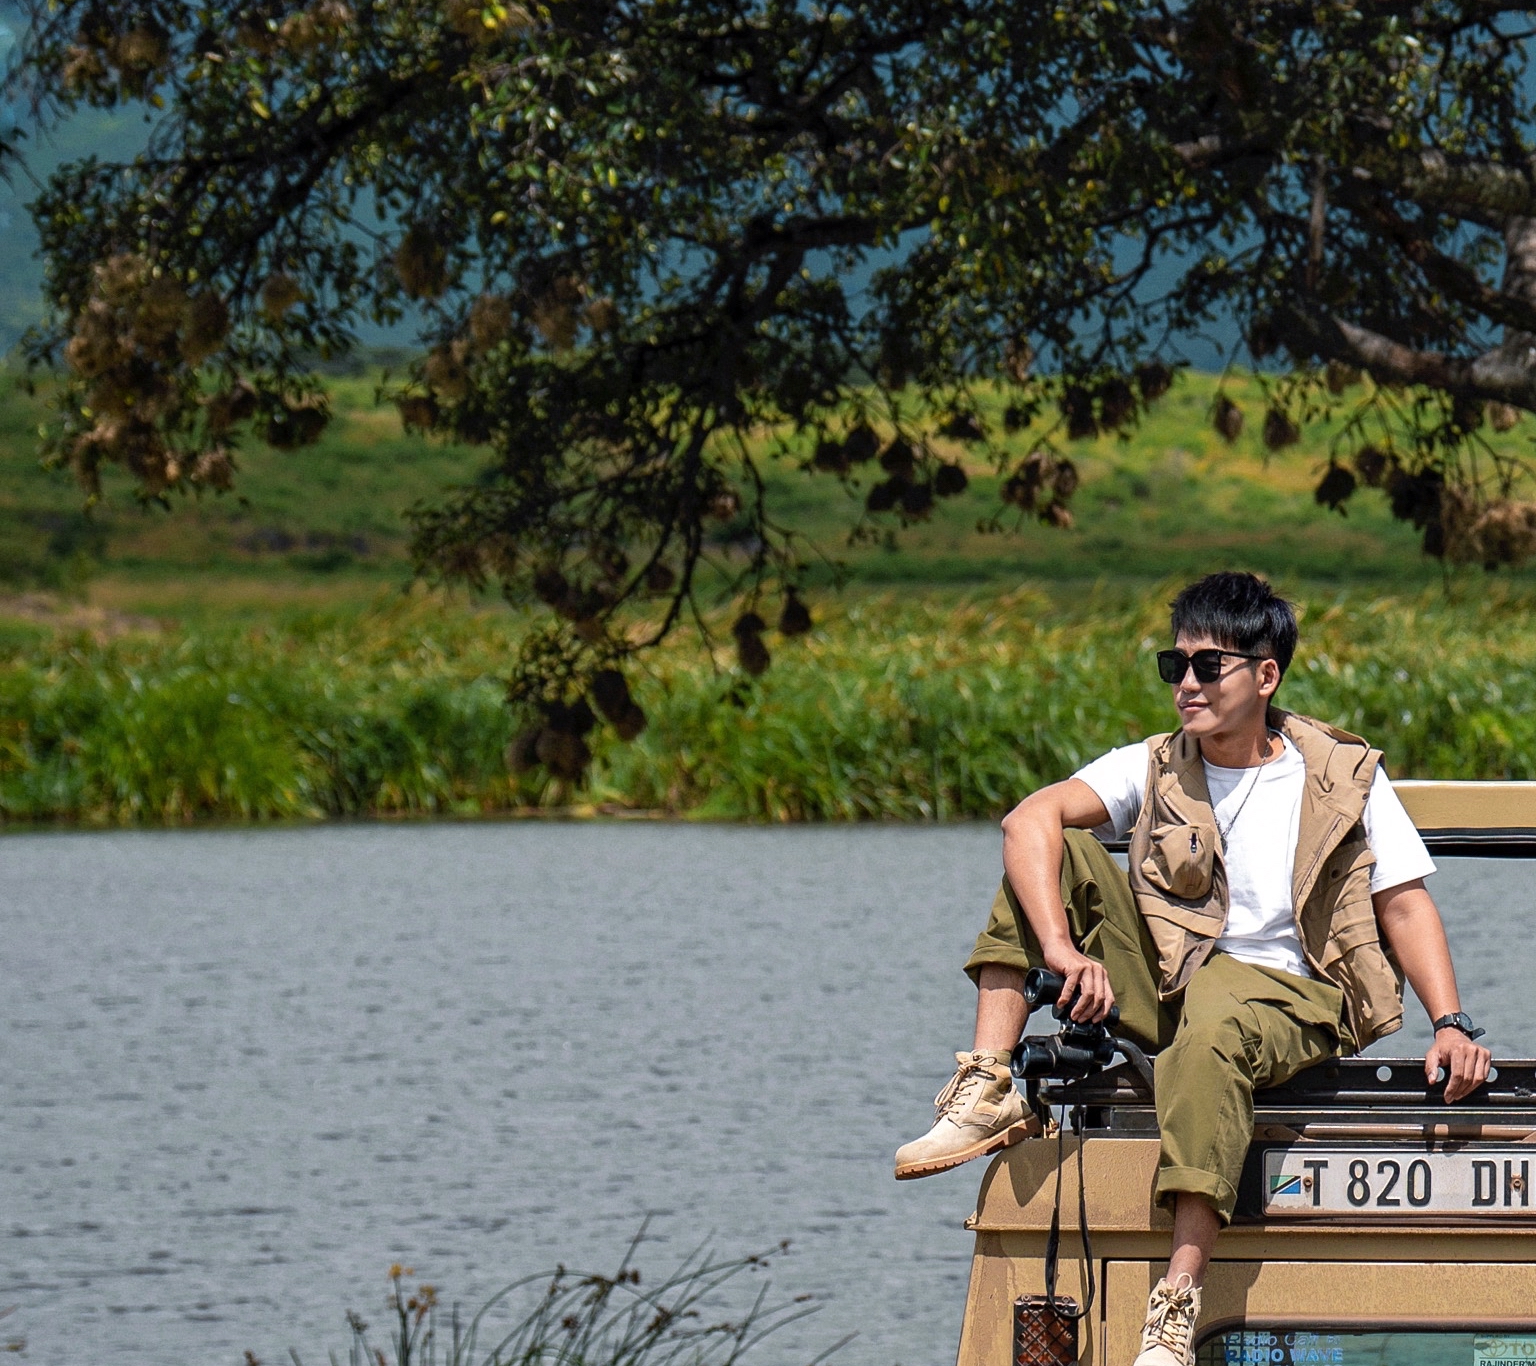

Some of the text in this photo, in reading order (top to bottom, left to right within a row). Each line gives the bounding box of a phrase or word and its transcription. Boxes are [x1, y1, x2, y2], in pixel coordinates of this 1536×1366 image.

[1303, 1160, 1328, 1206] T
[1347, 1158, 1431, 1207] 820
[1226, 1348, 1343, 1363] RADIO WAVE
